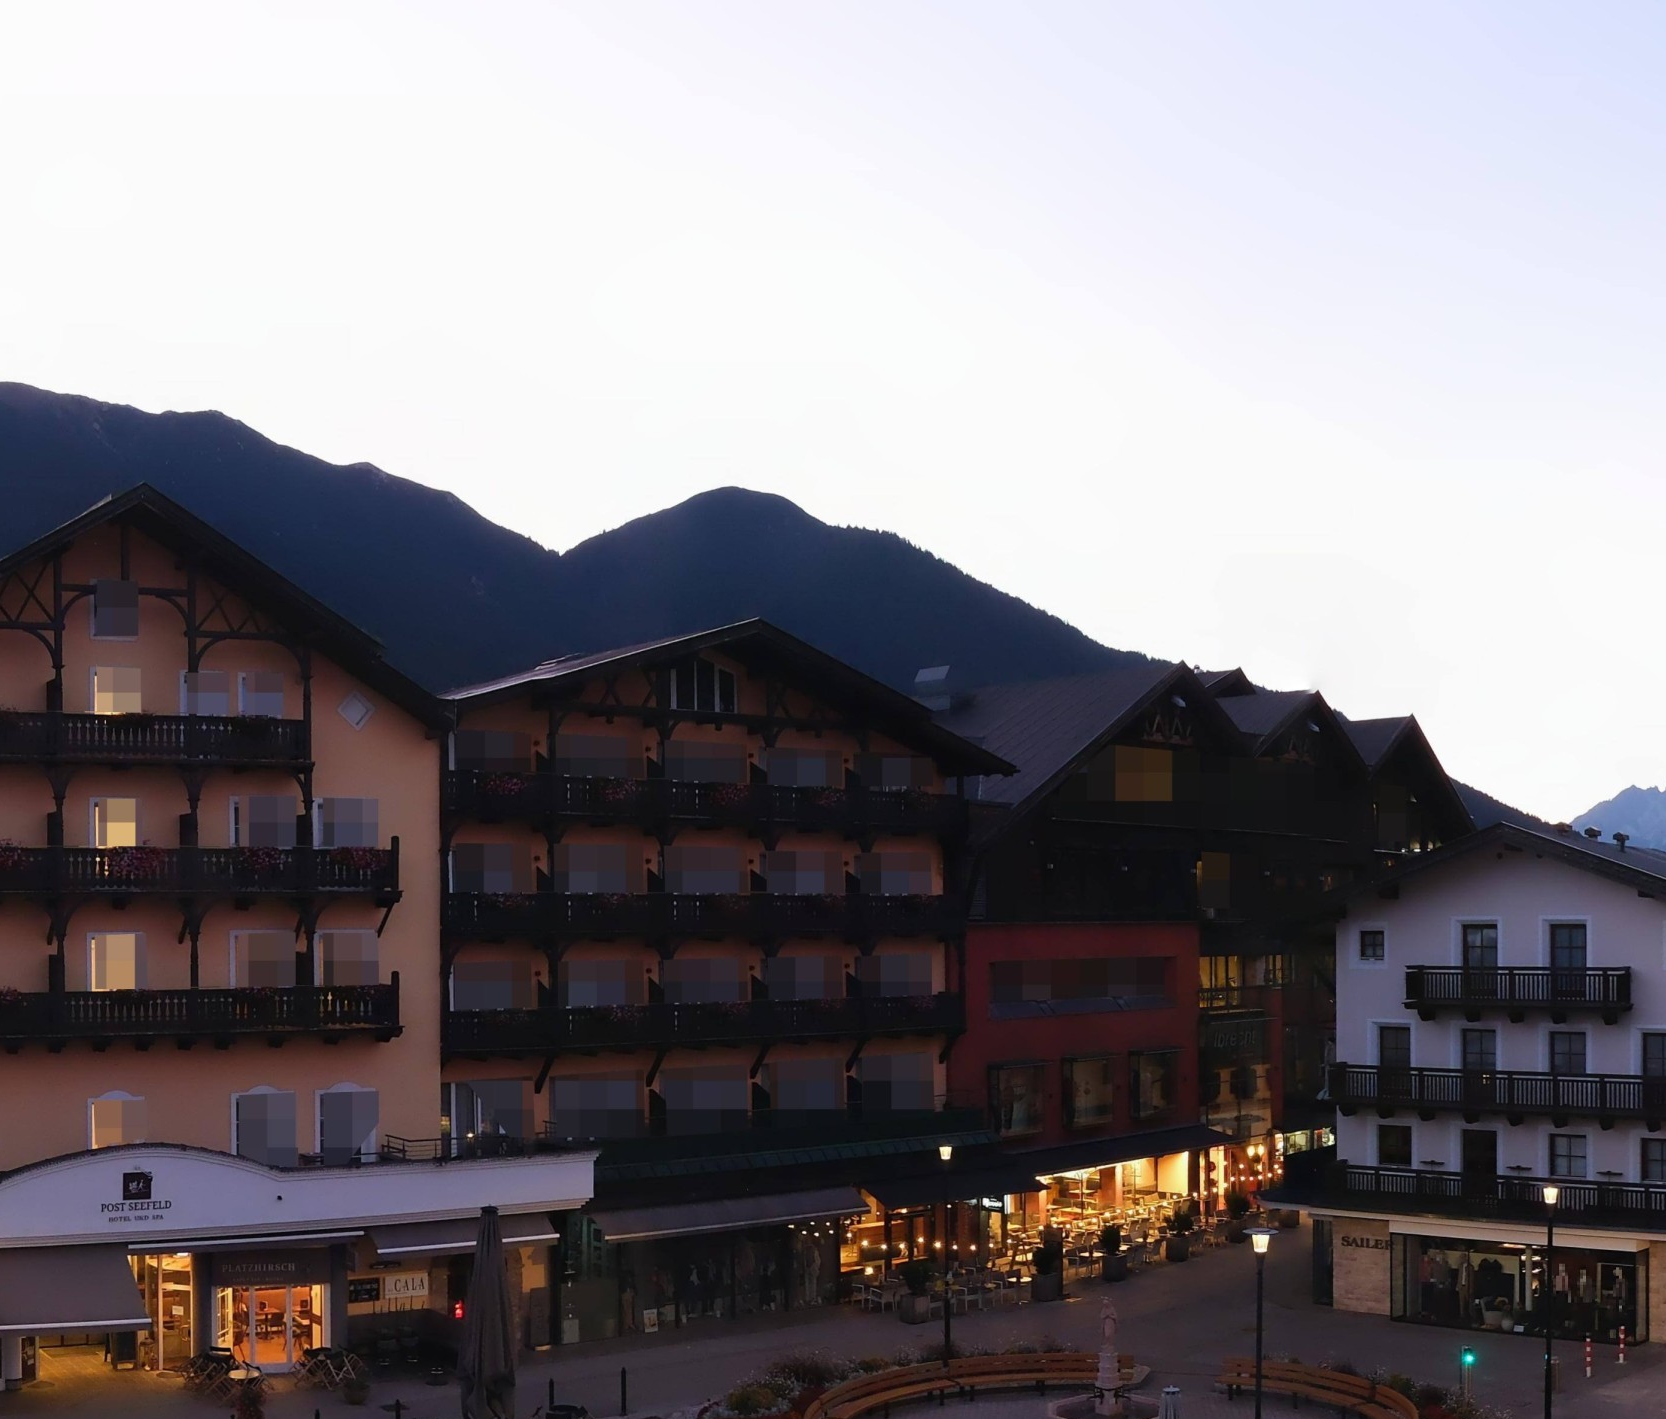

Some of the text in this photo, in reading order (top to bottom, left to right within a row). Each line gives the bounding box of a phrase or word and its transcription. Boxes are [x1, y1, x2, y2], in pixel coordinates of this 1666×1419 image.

[101, 1200, 172, 1213] POST SEEFELD
[108, 1215, 132, 1223] HOTEL
[222, 1262, 296, 1273] PLATZHIRSCH
